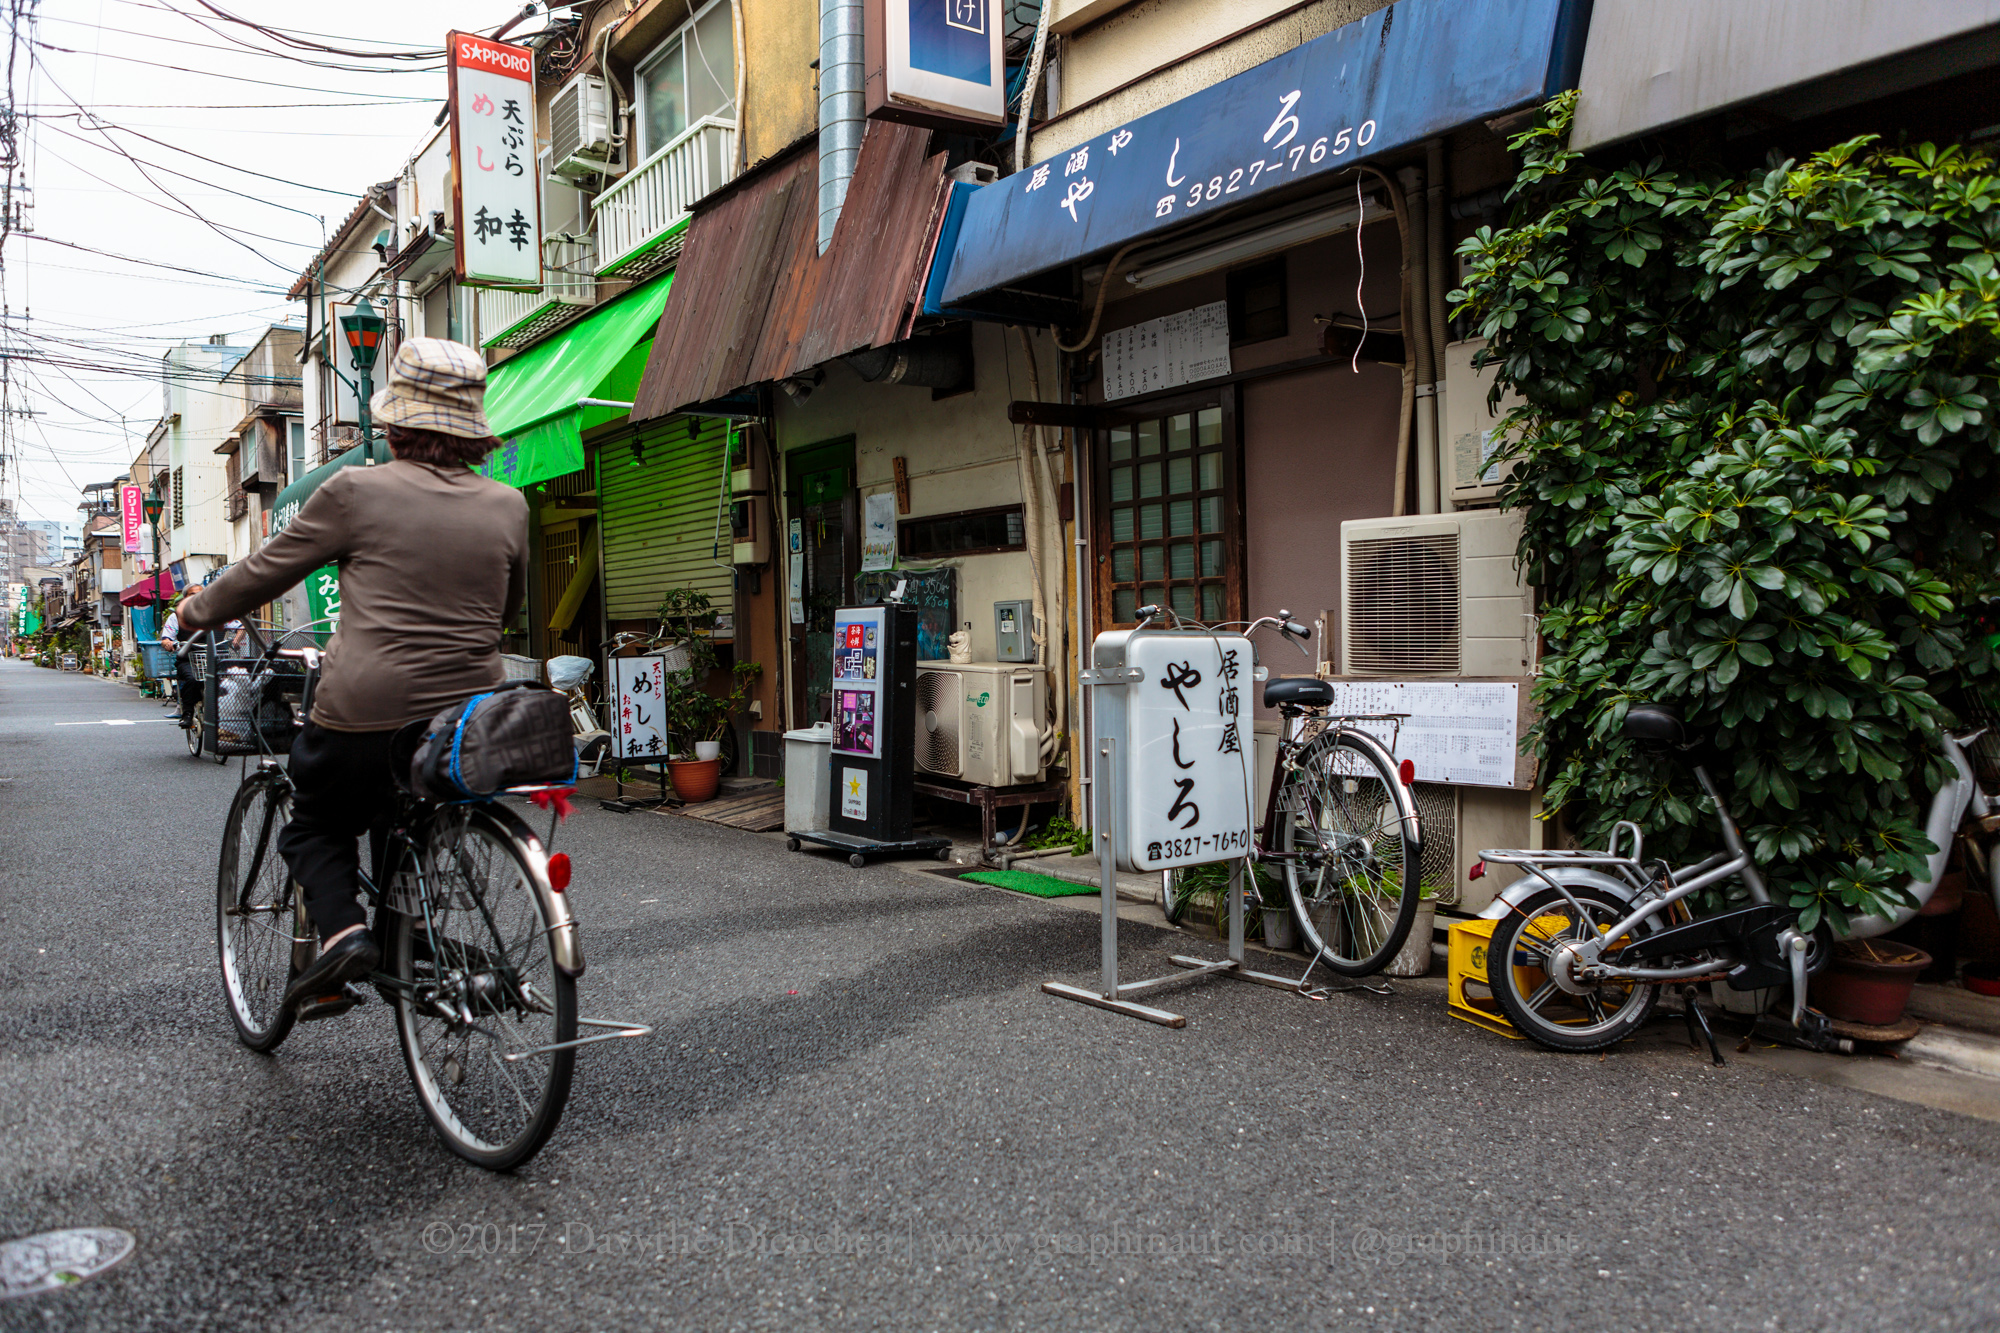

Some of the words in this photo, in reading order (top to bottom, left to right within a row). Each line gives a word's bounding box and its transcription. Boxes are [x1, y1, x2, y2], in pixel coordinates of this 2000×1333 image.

[471, 92, 495, 172] めし
[502, 99, 524, 177] 天ぷら
[1025, 129, 1133, 193] 居酒や
[1060, 90, 1301, 223] やしろ
[1185, 120, 1377, 208] 3827-7650
[473, 205, 532, 252] 和幸
[127, 490, 138, 539] クリーニング
[622, 694, 633, 735] お弁当
[632, 671, 653, 726] めし
[1216, 649, 1241, 755] 居酒屋
[626, 734, 662, 757] 和幸
[1160, 660, 1202, 830] やしろ
[1164, 829, 1248, 859] 3827-7650
